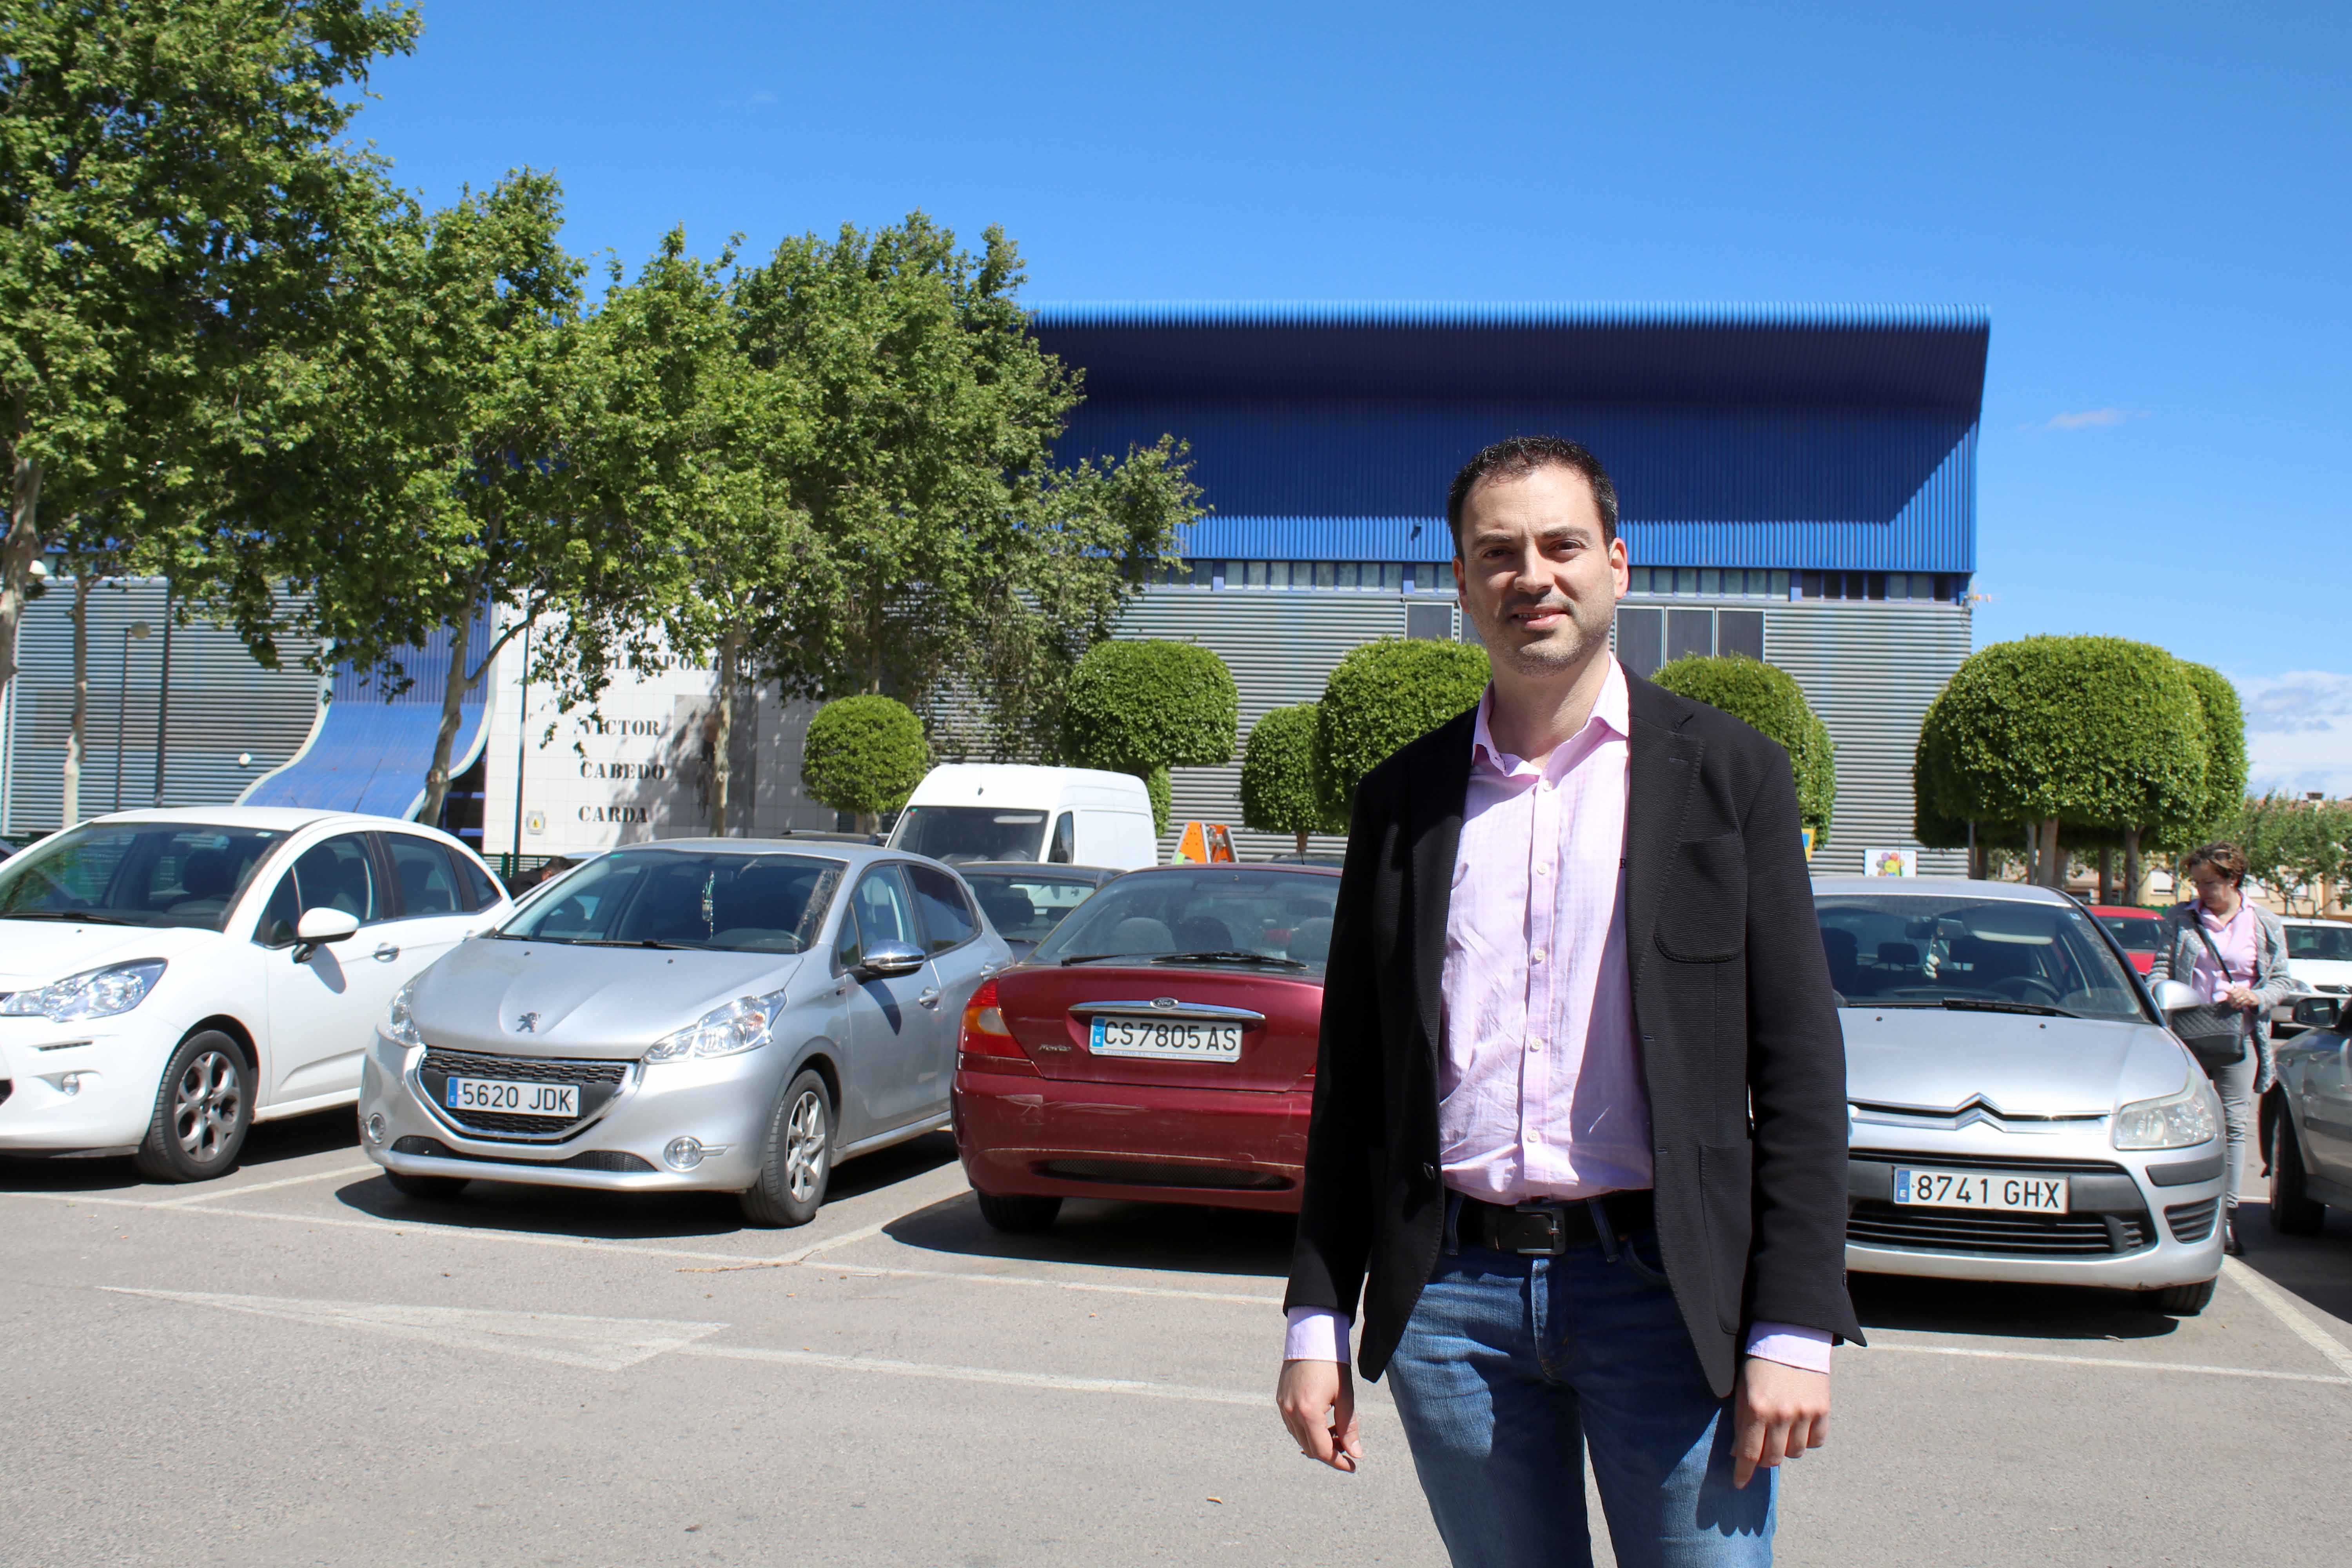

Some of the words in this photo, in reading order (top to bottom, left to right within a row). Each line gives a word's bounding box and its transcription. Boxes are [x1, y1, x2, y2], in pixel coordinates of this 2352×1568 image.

[580, 761, 665, 780] CABEDO
[578, 806, 648, 823] CARDA
[463, 1083, 519, 1108] 5620
[528, 1088, 572, 1112] JDK
[1917, 1175, 1988, 1204] 8741
[2004, 1180, 2060, 1208] GHX
